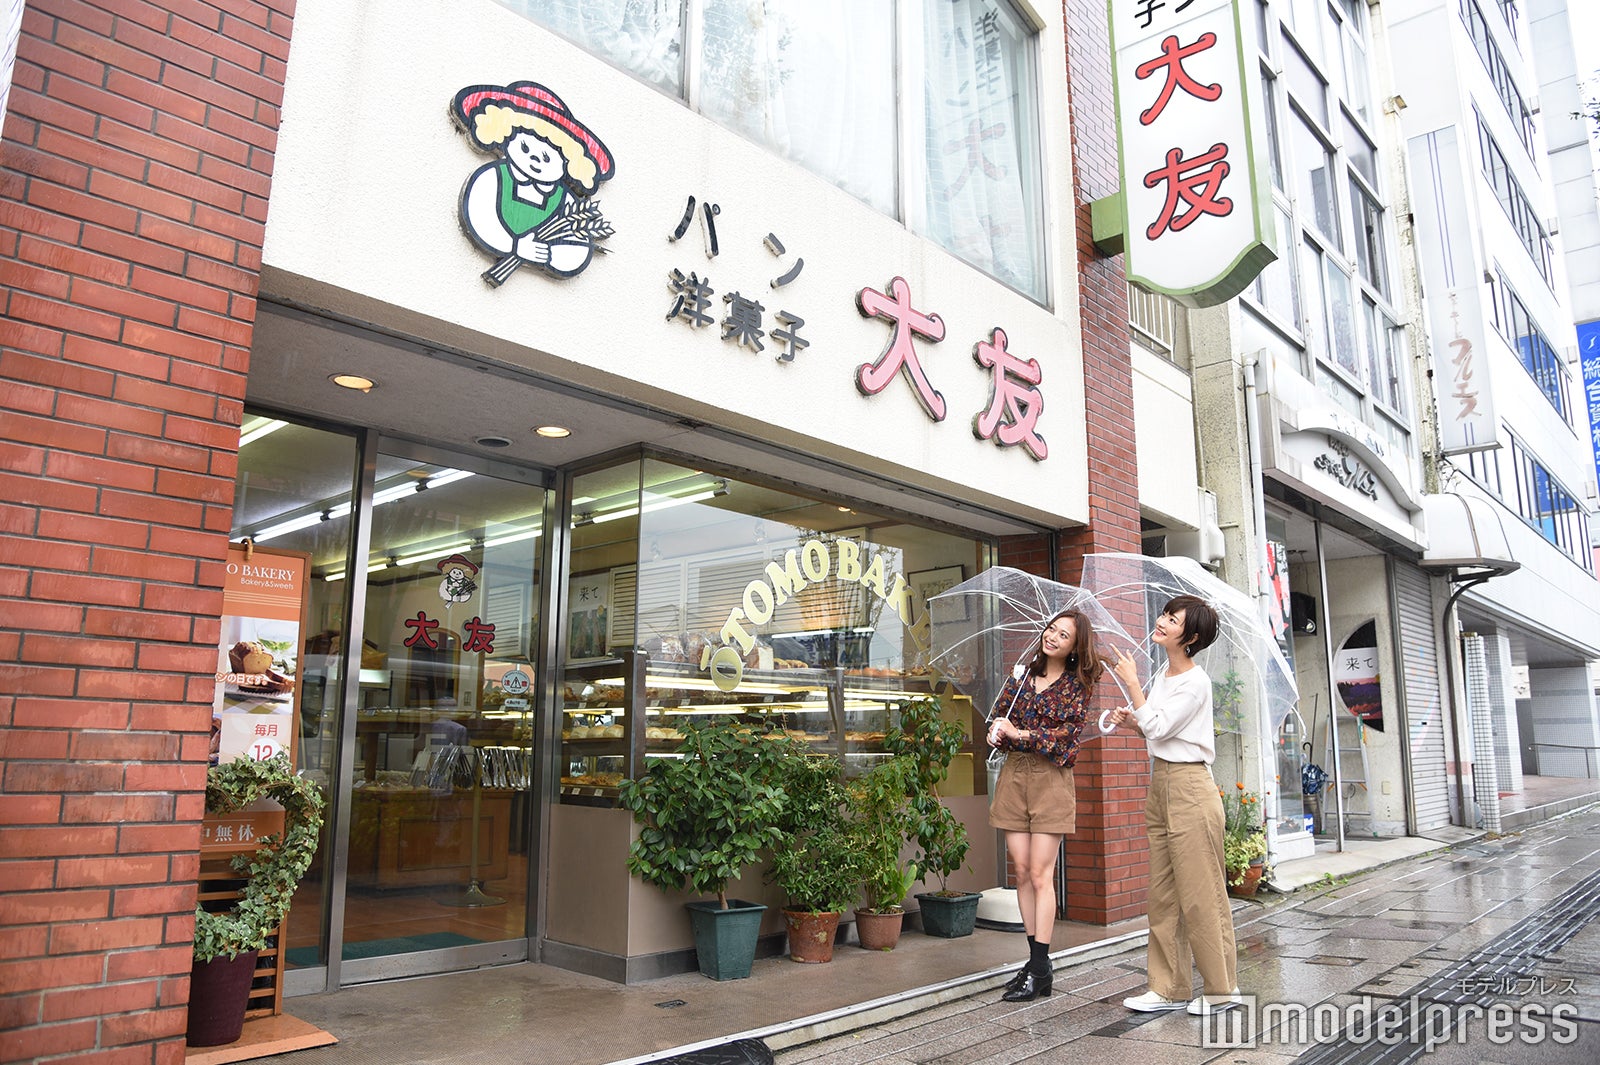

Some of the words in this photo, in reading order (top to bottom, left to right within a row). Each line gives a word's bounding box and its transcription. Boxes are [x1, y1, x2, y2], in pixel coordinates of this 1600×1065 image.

[1134, 31, 1234, 241] 大友
[667, 195, 804, 289] パン
[667, 267, 810, 363] 洋菓子
[854, 276, 1048, 462] 大友
[240, 577, 294, 590] Bakery&Sweets
[242, 564, 295, 581] BAKERY
[403, 610, 497, 654] 大友
[255, 724, 278, 736] 毎月
[254, 745, 273, 761] 12
